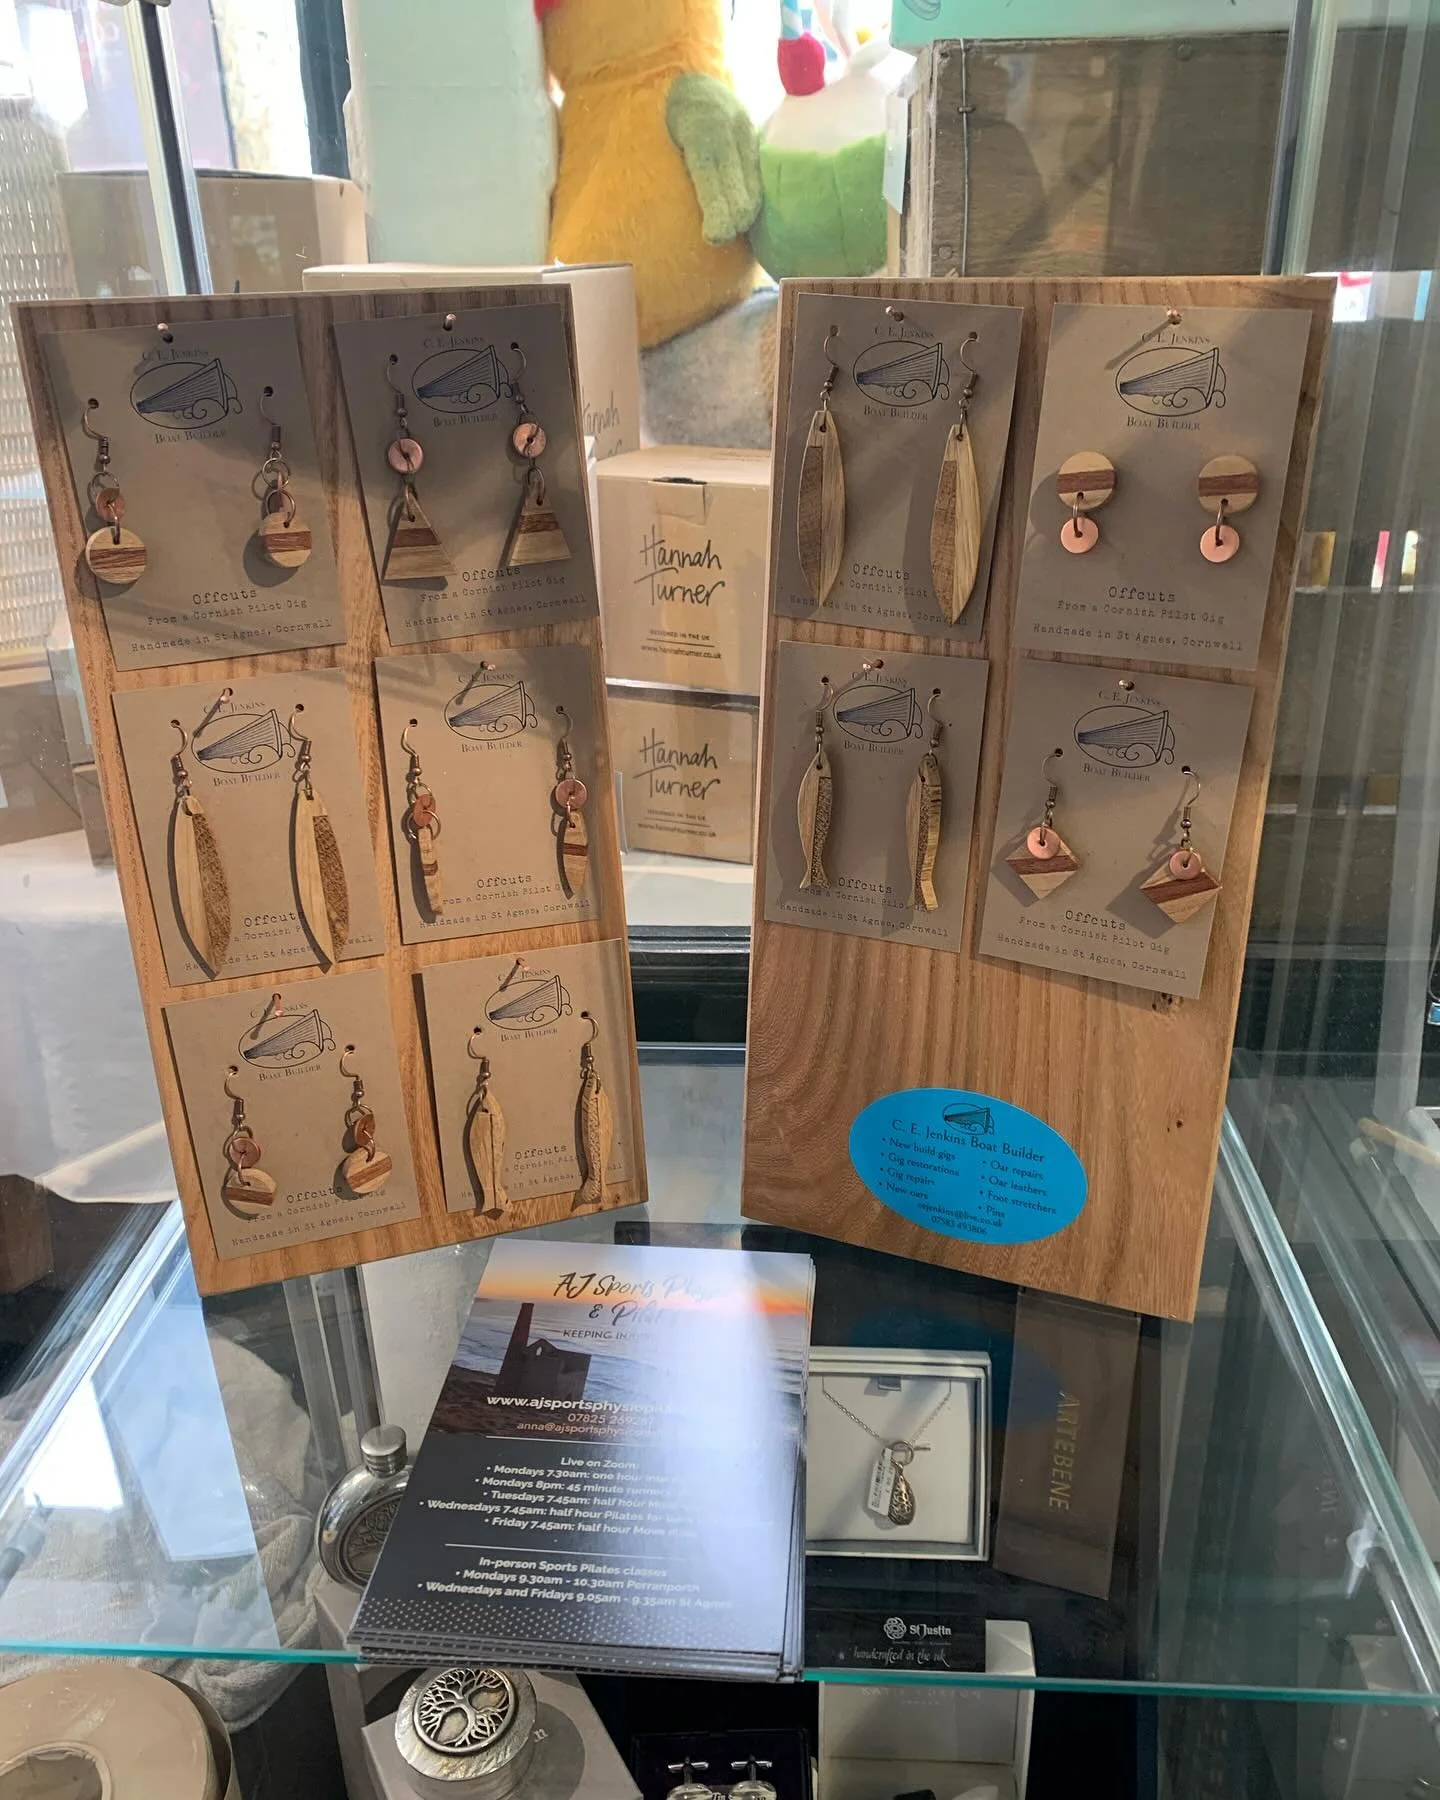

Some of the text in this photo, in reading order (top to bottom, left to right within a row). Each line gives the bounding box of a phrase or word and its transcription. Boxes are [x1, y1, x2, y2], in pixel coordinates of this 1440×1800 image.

[639, 522, 723, 570] Hannah
[461, 565, 521, 583] Offcuts
[851, 563, 911, 581] Offcuts
[192, 588, 258, 606] Offcuts
[419, 578, 542, 603] From Cornish Pilot
[633, 566, 726, 607] Turner
[849, 579, 898, 594] Cornish
[1107, 585, 1177, 603] Offcuts
[147, 600, 308, 627] From Cornish Pilot Gig
[404, 613, 460, 628] Handmade
[463, 610, 478, 620] in
[480, 607, 495, 618] St
[536, 594, 587, 610] Cornwall
[861, 603, 913, 620] St Agnes,
[1055, 600, 1225, 626] From Cornish Pilot Gig
[131, 619, 333, 652] Handmade in St Agnes, Cornwall
[1032, 622, 1243, 652] Handmade in St Agnes, Cornwall
[638, 727, 719, 771] Hannah
[631, 764, 721, 801] Turner
[476, 873, 533, 889] Offcuts
[837, 876, 894, 895] Offcuts
[475, 889, 519, 903] Cornish
[523, 885, 552, 897] Pilot
[835, 891, 876, 905] Cornish
[491, 899, 591, 921] St Cornwall
[780, 903, 950, 938] Handmade St Cornwall
[1064, 909, 1127, 931] Offcuts
[243, 928, 291, 941] Cornish
[1018, 916, 1171, 956] From Cornish Pilot Gig
[263, 949, 276, 960] St
[997, 933, 1187, 980] Handmade in St Agnes, Cornwall
[514, 1144, 568, 1160] Offcuts
[889, 1136, 957, 1164] New build gigs
[891, 1118, 1046, 1164] C. E. Jenkins Boat Builder
[887, 1151, 960, 1177] Gig restorations
[989, 1158, 1045, 1181] Oar repairs
[887, 1166, 936, 1188] Gig repairs
[987, 1175, 1048, 1198] Oar leathers
[285, 1185, 343, 1205] Offcuts
[886, 1181, 929, 1200] New oars
[286, 1201, 330, 1216] Cornish
[985, 1204, 1006, 1219] Pins
[987, 1190, 1057, 1216] Foot stretchers
[231, 1229, 284, 1247] Handmade
[304, 1220, 316, 1231] St
[357, 1201, 408, 1219] Cornwall
[553, 1271, 597, 1300] AJ
[592, 1273, 656, 1297] Sports
[588, 1303, 604, 1320] &
[562, 1328, 613, 1340] KEEPING
[560, 1456, 585, 1468] Live
[586, 1459, 602, 1468] on
[1047, 1390, 1081, 1512] ARTEBENE
[493, 1463, 544, 1479] Mondays
[545, 1467, 591, 1481] 7.30am:
[592, 1471, 614, 1481] one
[616, 1471, 642, 1483] hour
[481, 1476, 623, 1495] Mondays 8pm: 45 minute
[426, 1498, 644, 1522] Wednesdays 7.45am: half hour Pilates
[491, 1489, 544, 1504] Tuesdays
[546, 1492, 591, 1506] 7.45am:
[592, 1496, 615, 1507] half
[618, 1497, 646, 1509] hour
[492, 1516, 529, 1531] Friday
[530, 1518, 576, 1533] 7.45am:
[577, 1522, 601, 1533] half
[602, 1524, 631, 1535] hour
[478, 1556, 668, 1578] In-person Sports Pilates classes
[424, 1580, 502, 1597] Wednesdays
[504, 1586, 528, 1599] and
[529, 1587, 574, 1604] Fridays
[575, 1591, 622, 1604] 9.05am
[462, 1569, 700, 1594] Mondays 9.30am 10.30am Perranporth
[853, 1644, 952, 1668] handcrafted in the uk
